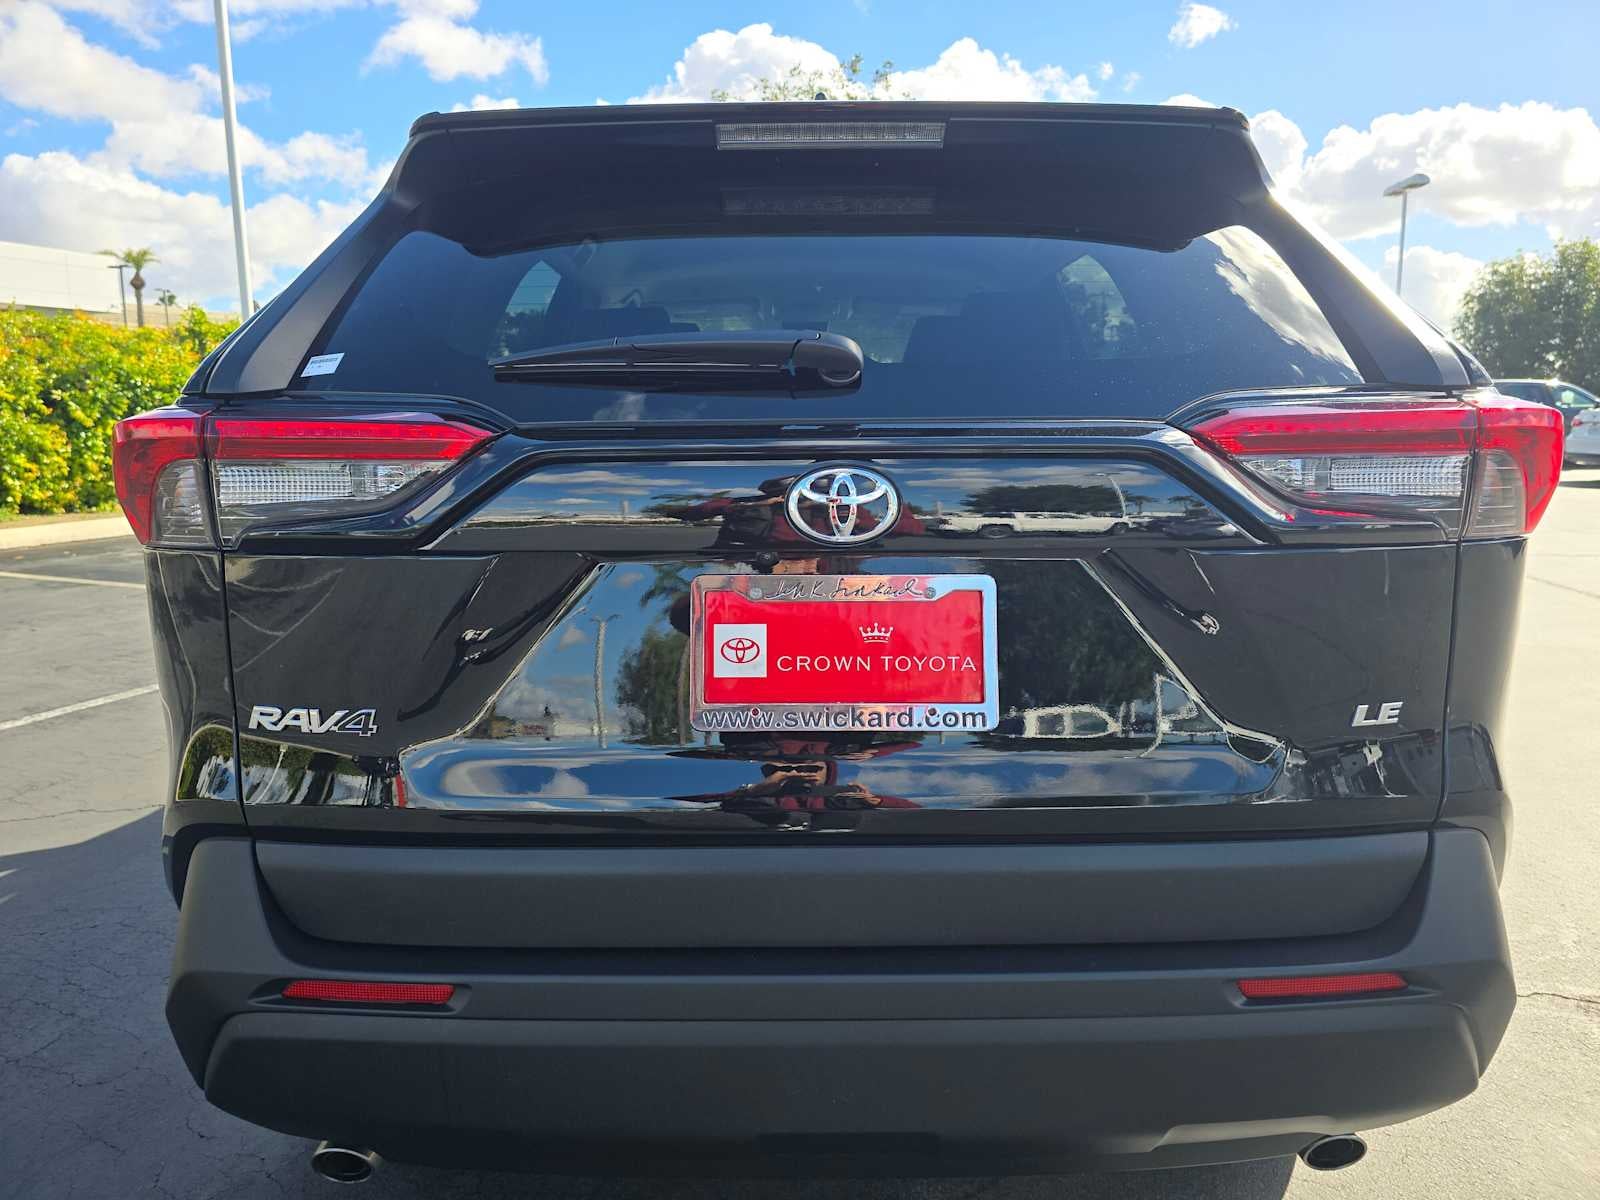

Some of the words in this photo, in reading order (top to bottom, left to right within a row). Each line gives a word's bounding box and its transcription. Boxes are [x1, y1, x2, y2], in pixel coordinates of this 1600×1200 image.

[776, 655, 871, 673] CROWN
[880, 655, 977, 672] TOYOTA
[248, 705, 378, 737] RAV4
[702, 706, 988, 730] www.swickard.com
[1351, 701, 1404, 727] LE
